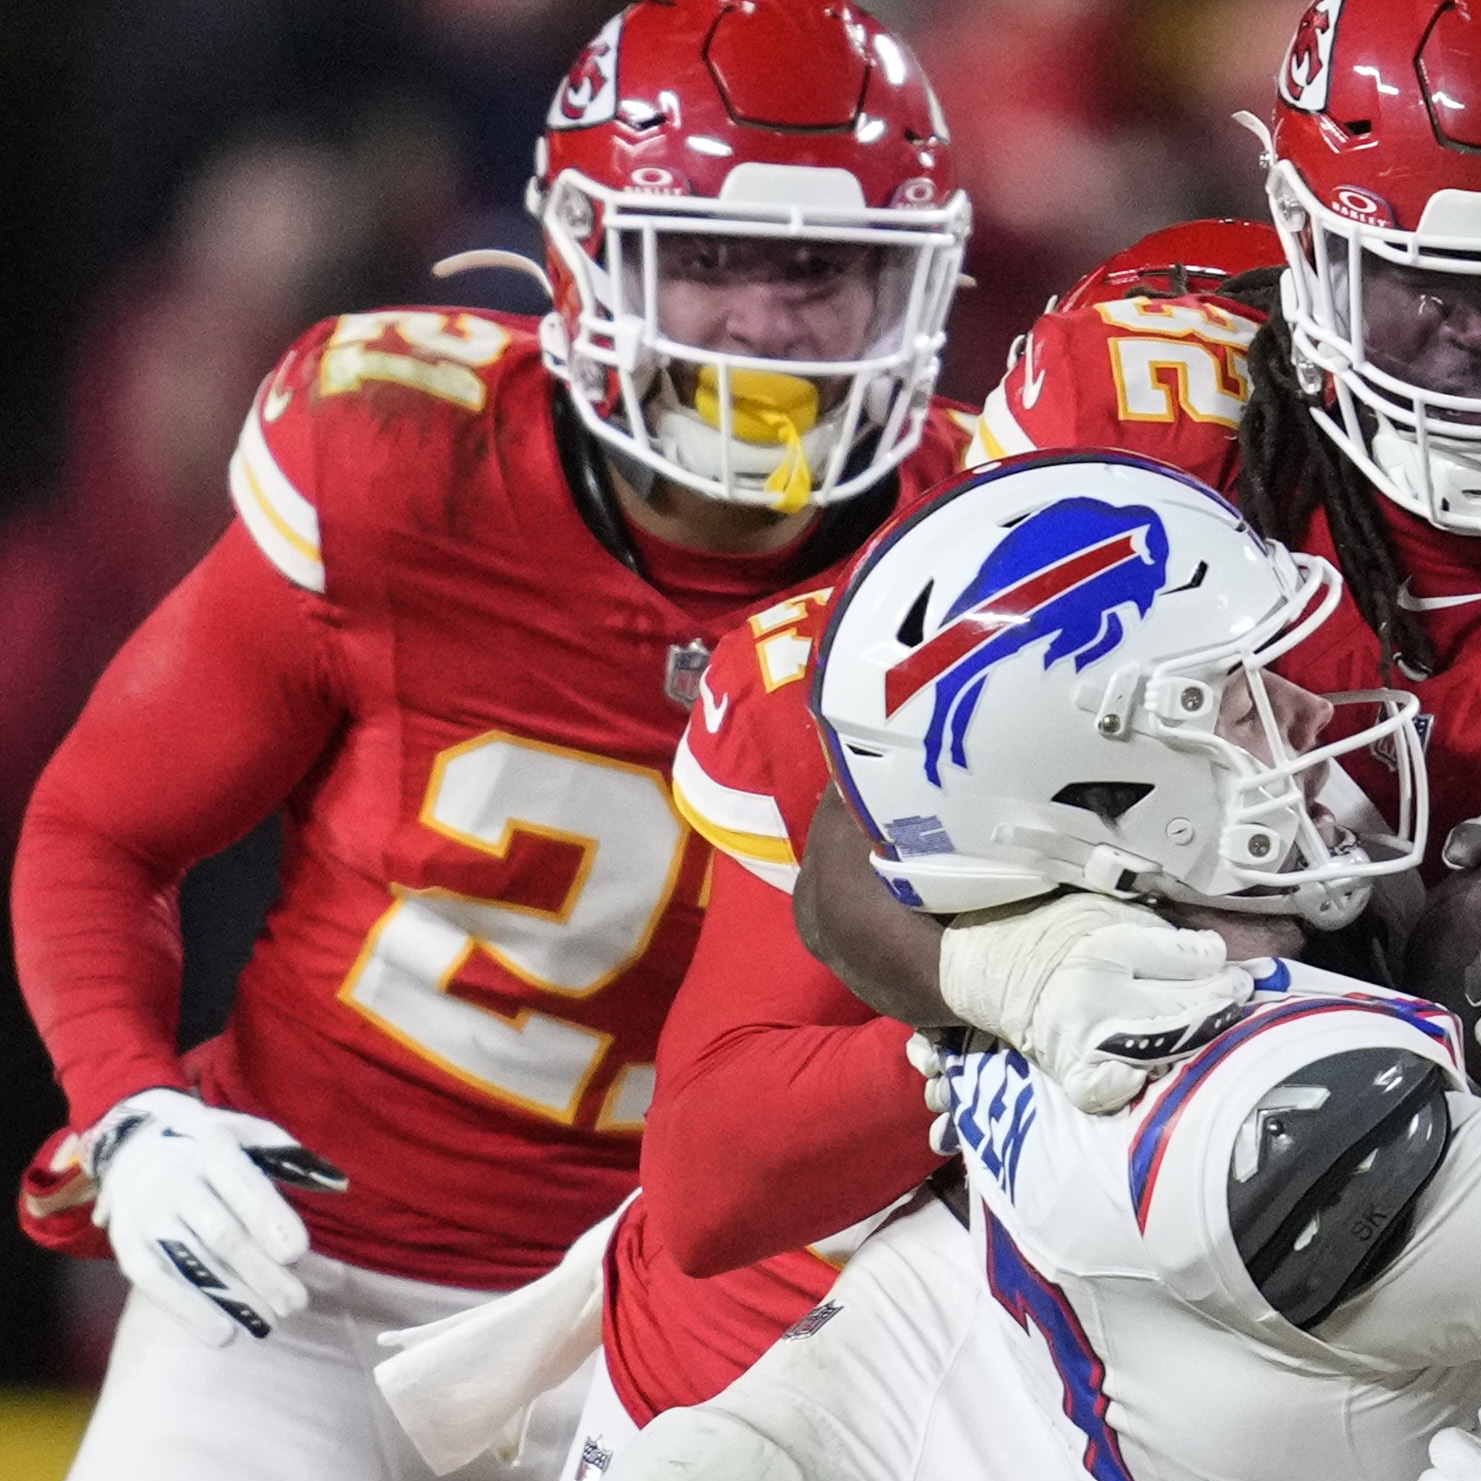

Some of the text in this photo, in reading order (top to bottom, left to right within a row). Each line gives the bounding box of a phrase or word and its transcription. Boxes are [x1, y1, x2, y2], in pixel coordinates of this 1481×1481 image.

[319, 311, 513, 414] 21
[1093, 296, 1263, 430] 32
[336, 729, 714, 1132] 2
